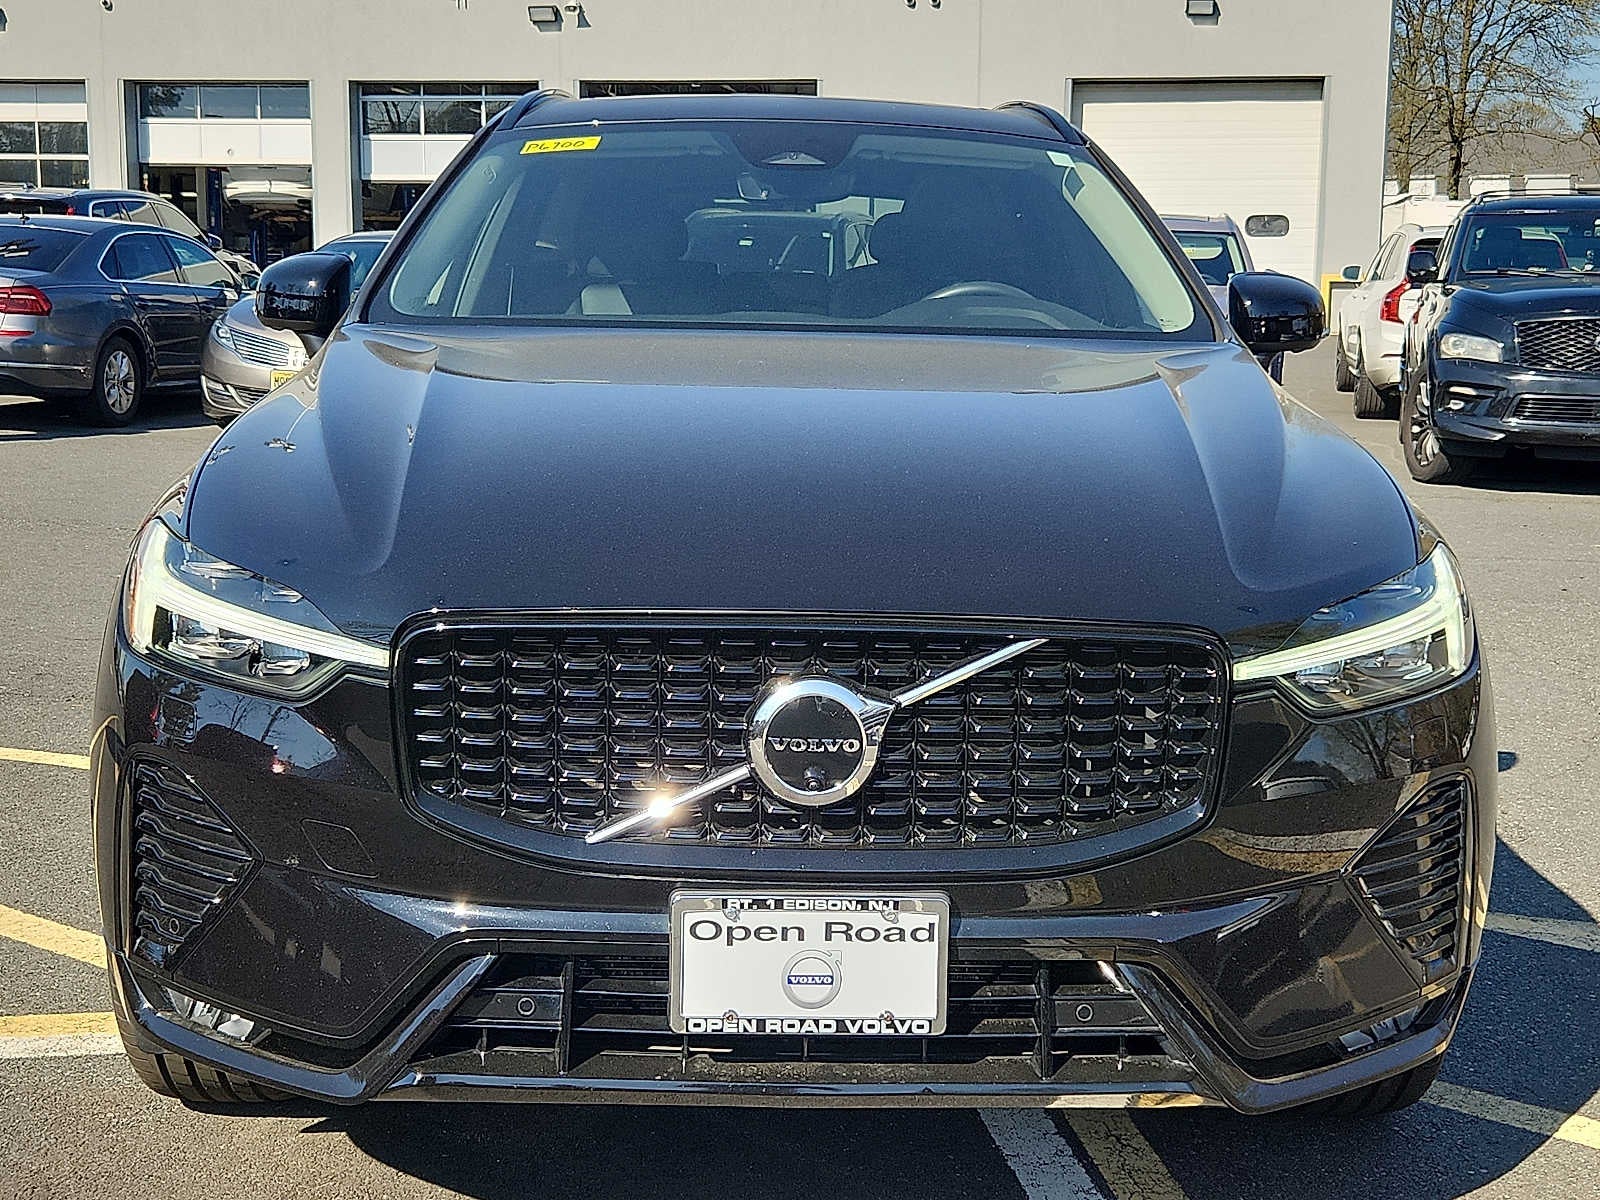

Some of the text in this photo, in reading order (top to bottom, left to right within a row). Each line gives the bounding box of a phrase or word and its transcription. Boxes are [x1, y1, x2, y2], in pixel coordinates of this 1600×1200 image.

[767, 736, 860, 753] VOLVO
[727, 899, 894, 911] RT. 1 EDISON, NJ
[689, 920, 935, 946] Open Road
[789, 975, 832, 984] VOLVO
[688, 1019, 930, 1034] OPEN ROAD VOLVO
